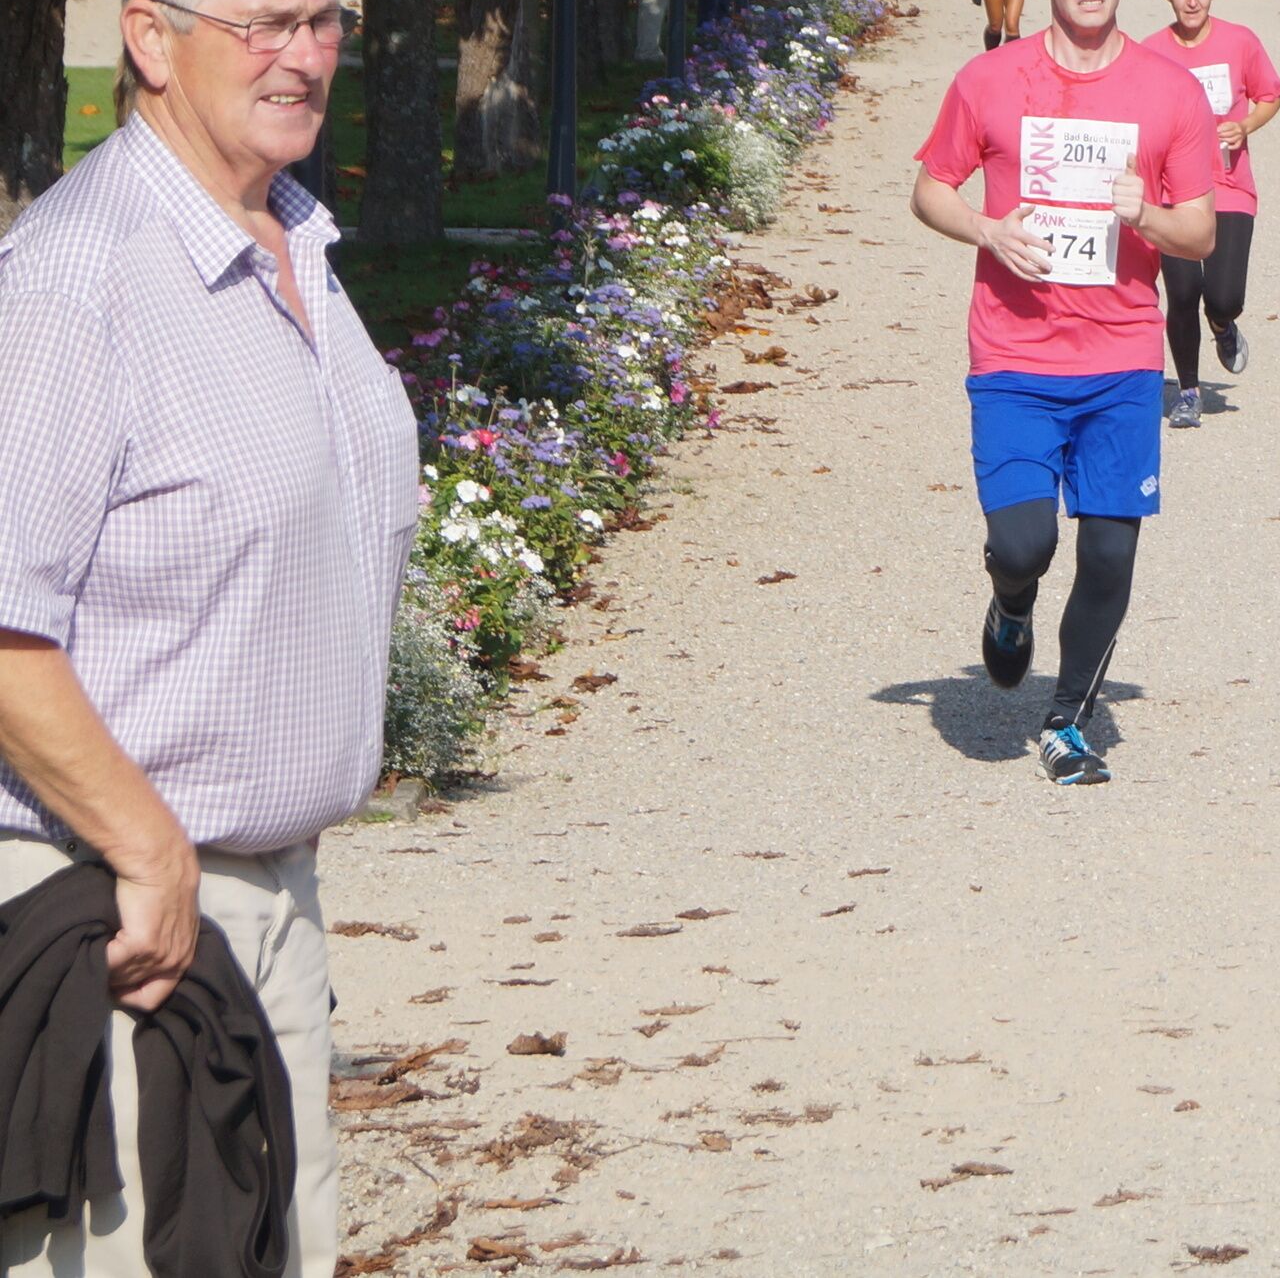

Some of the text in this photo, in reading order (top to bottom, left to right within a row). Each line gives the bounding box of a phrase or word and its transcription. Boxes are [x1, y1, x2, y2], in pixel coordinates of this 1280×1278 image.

[1063, 132, 1081, 142] Bad
[1024, 122, 1060, 197] PINK
[1062, 143, 1107, 163] 2014
[1033, 211, 1066, 228] PINK
[1042, 232, 1096, 261] 174
